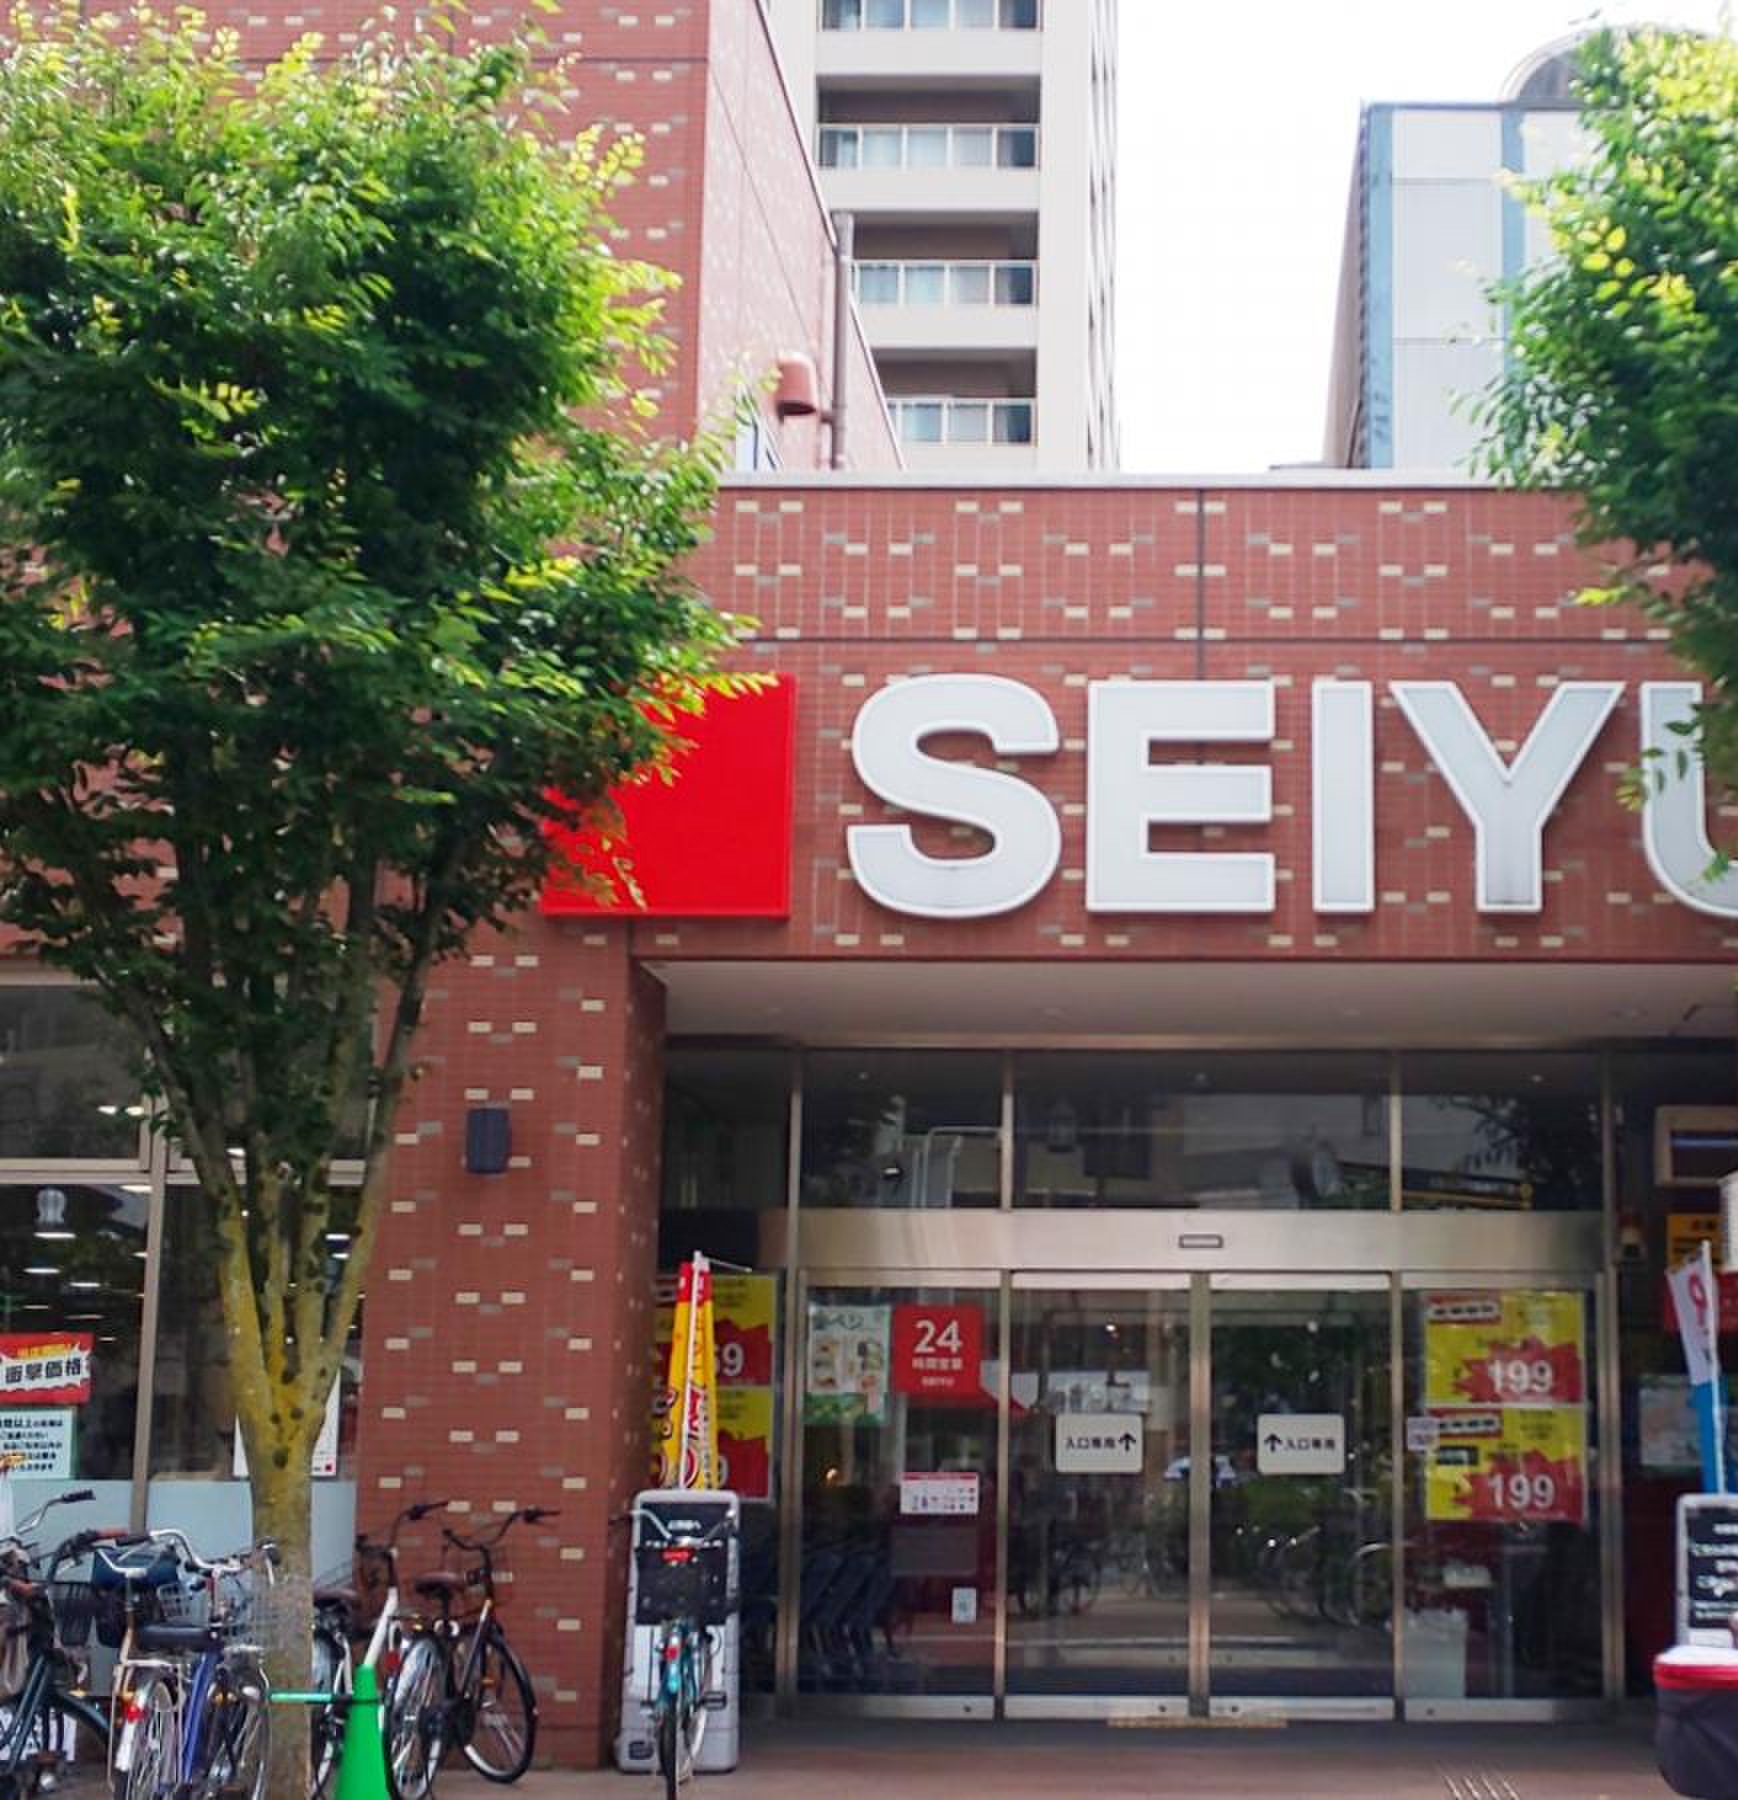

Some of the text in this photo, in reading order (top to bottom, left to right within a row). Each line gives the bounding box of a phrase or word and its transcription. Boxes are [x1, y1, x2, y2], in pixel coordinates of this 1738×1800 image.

[914, 1319, 964, 1354] 24
[1489, 1359, 1553, 1394] 199
[1489, 1472, 1555, 1509] 199
